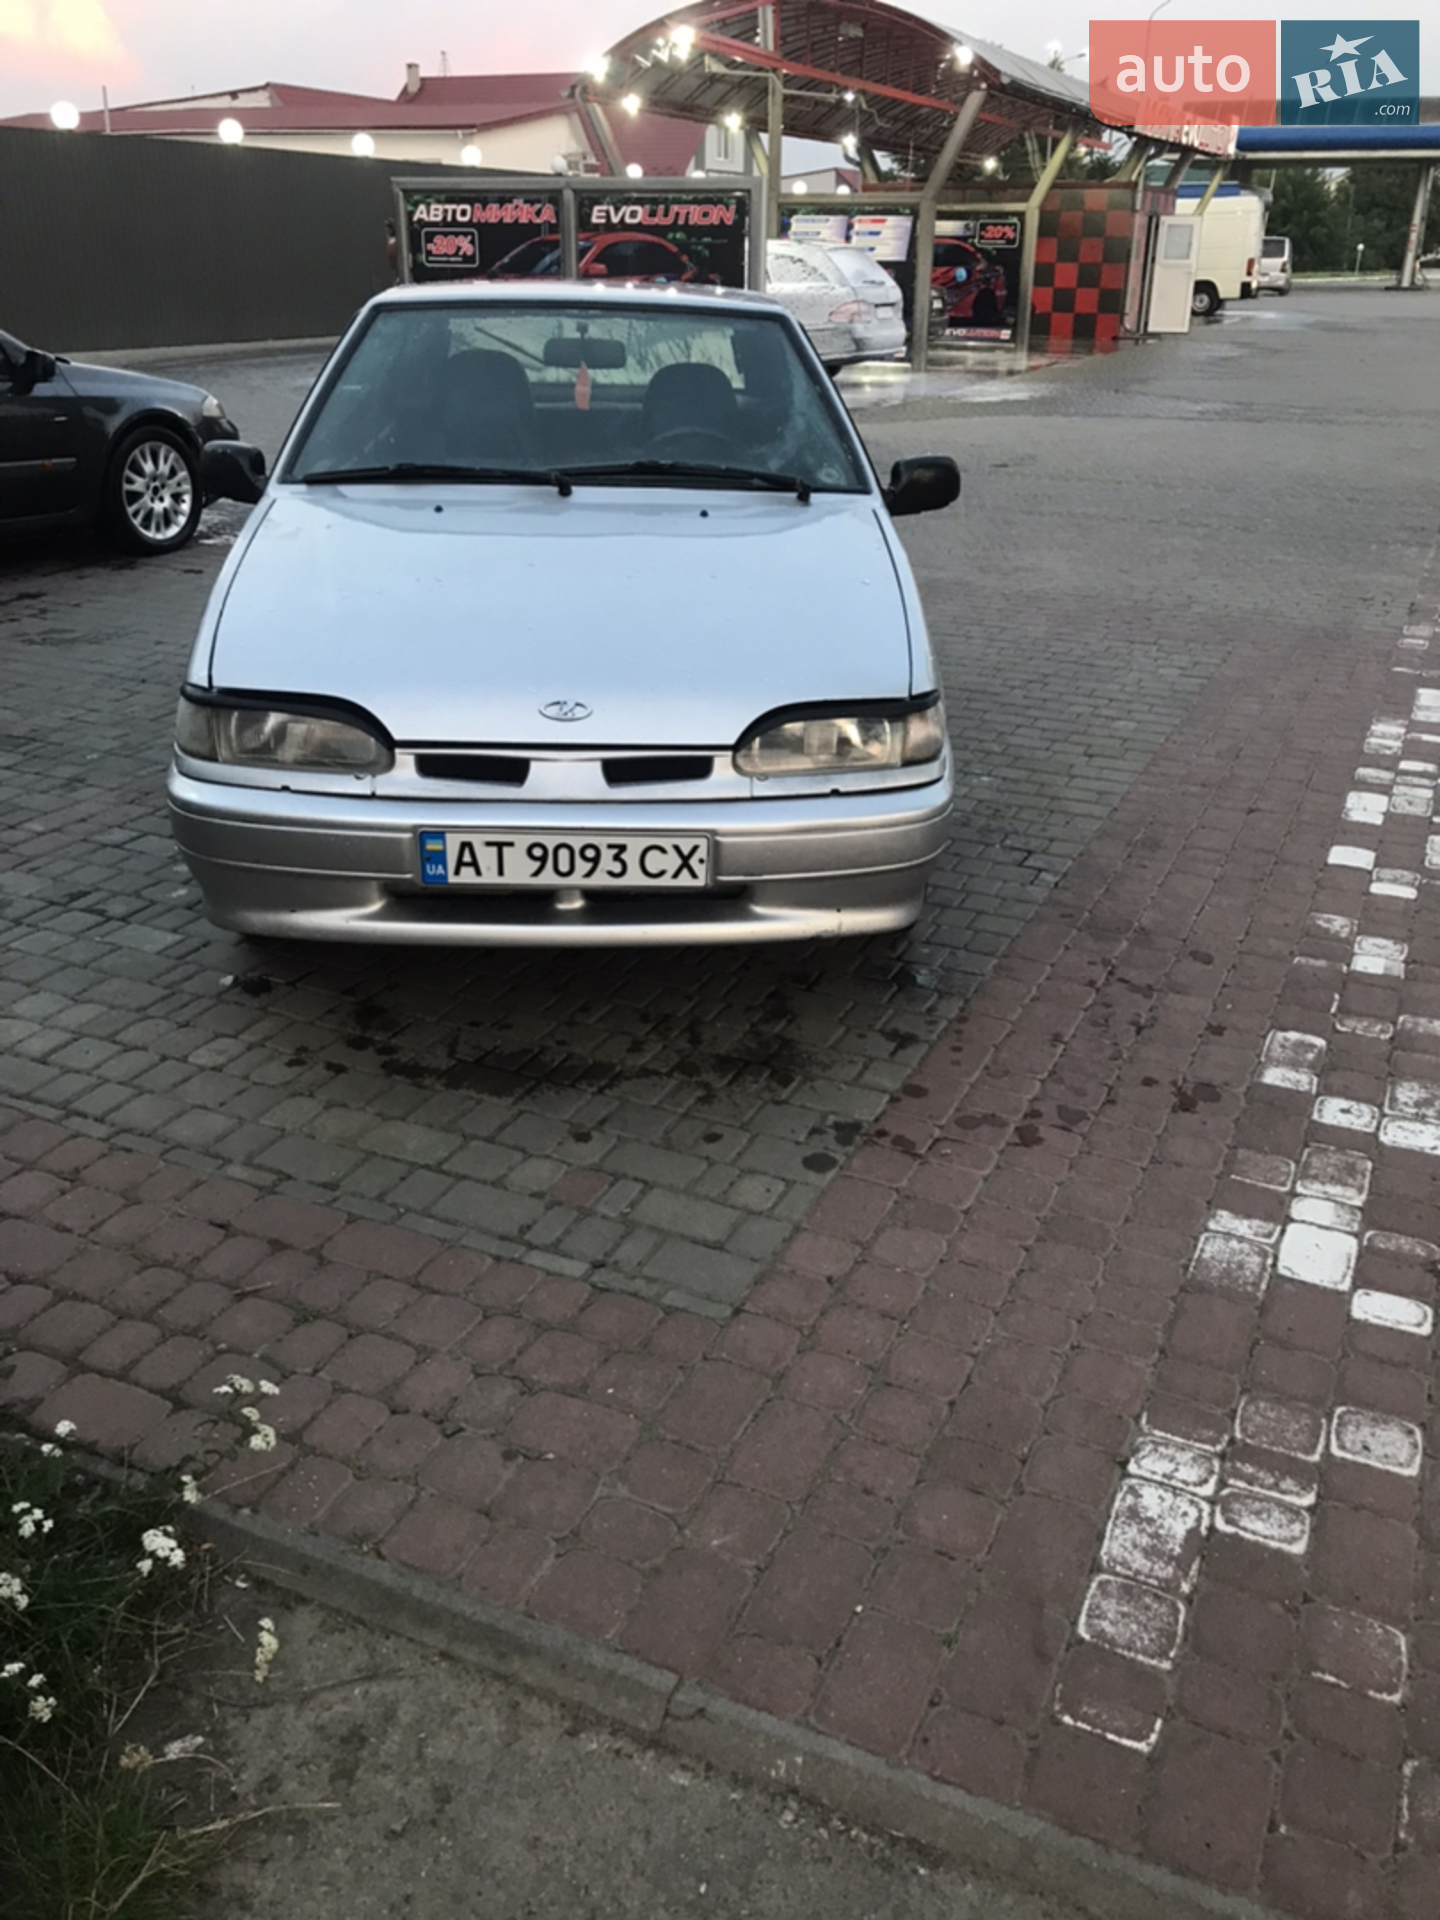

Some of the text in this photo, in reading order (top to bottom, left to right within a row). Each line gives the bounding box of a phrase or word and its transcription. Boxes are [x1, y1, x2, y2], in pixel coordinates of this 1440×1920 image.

[412, 198, 557, 224] АВТОМИЙКА
[590, 204, 736, 226] EVOLUTION
[981, 224, 1015, 239] -20%
[426, 234, 474, 256] -20%
[426, 864, 445, 876] UA
[453, 841, 515, 877] AT
[526, 842, 628, 878] 9093
